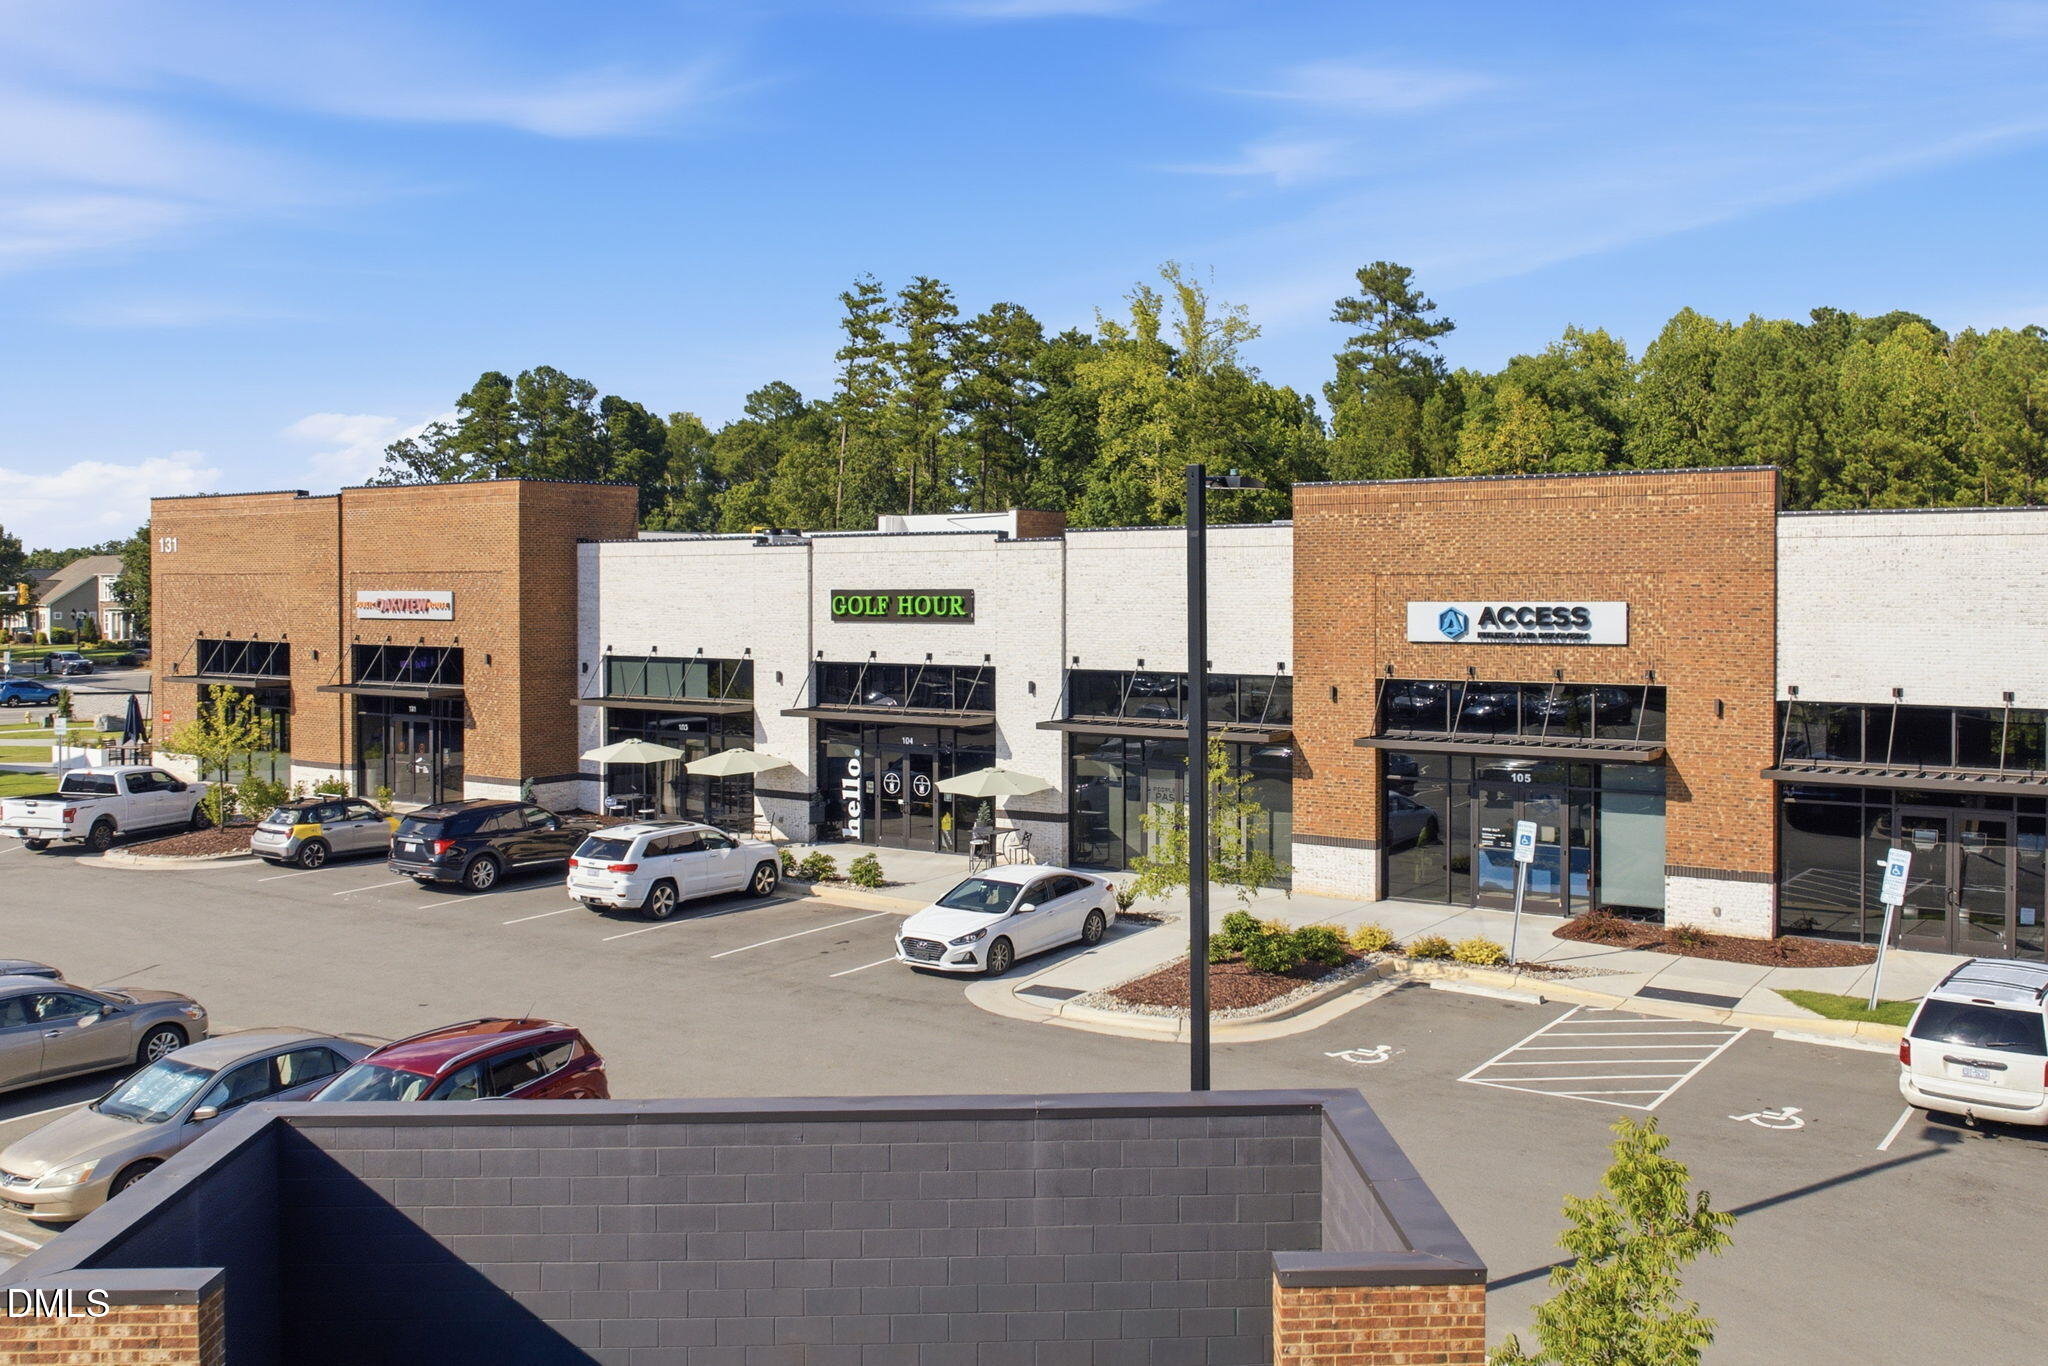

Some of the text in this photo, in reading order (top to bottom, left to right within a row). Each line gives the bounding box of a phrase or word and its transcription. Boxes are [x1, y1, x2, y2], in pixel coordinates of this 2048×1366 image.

[159, 537, 177, 552] 131
[377, 599, 430, 612] OAKVIEW
[832, 595, 968, 615] GOLF HOUR
[1478, 606, 1590, 627] ACCESS
[902, 737, 914, 745] 104
[1511, 773, 1532, 783] 105
[842, 749, 860, 839] hello.
